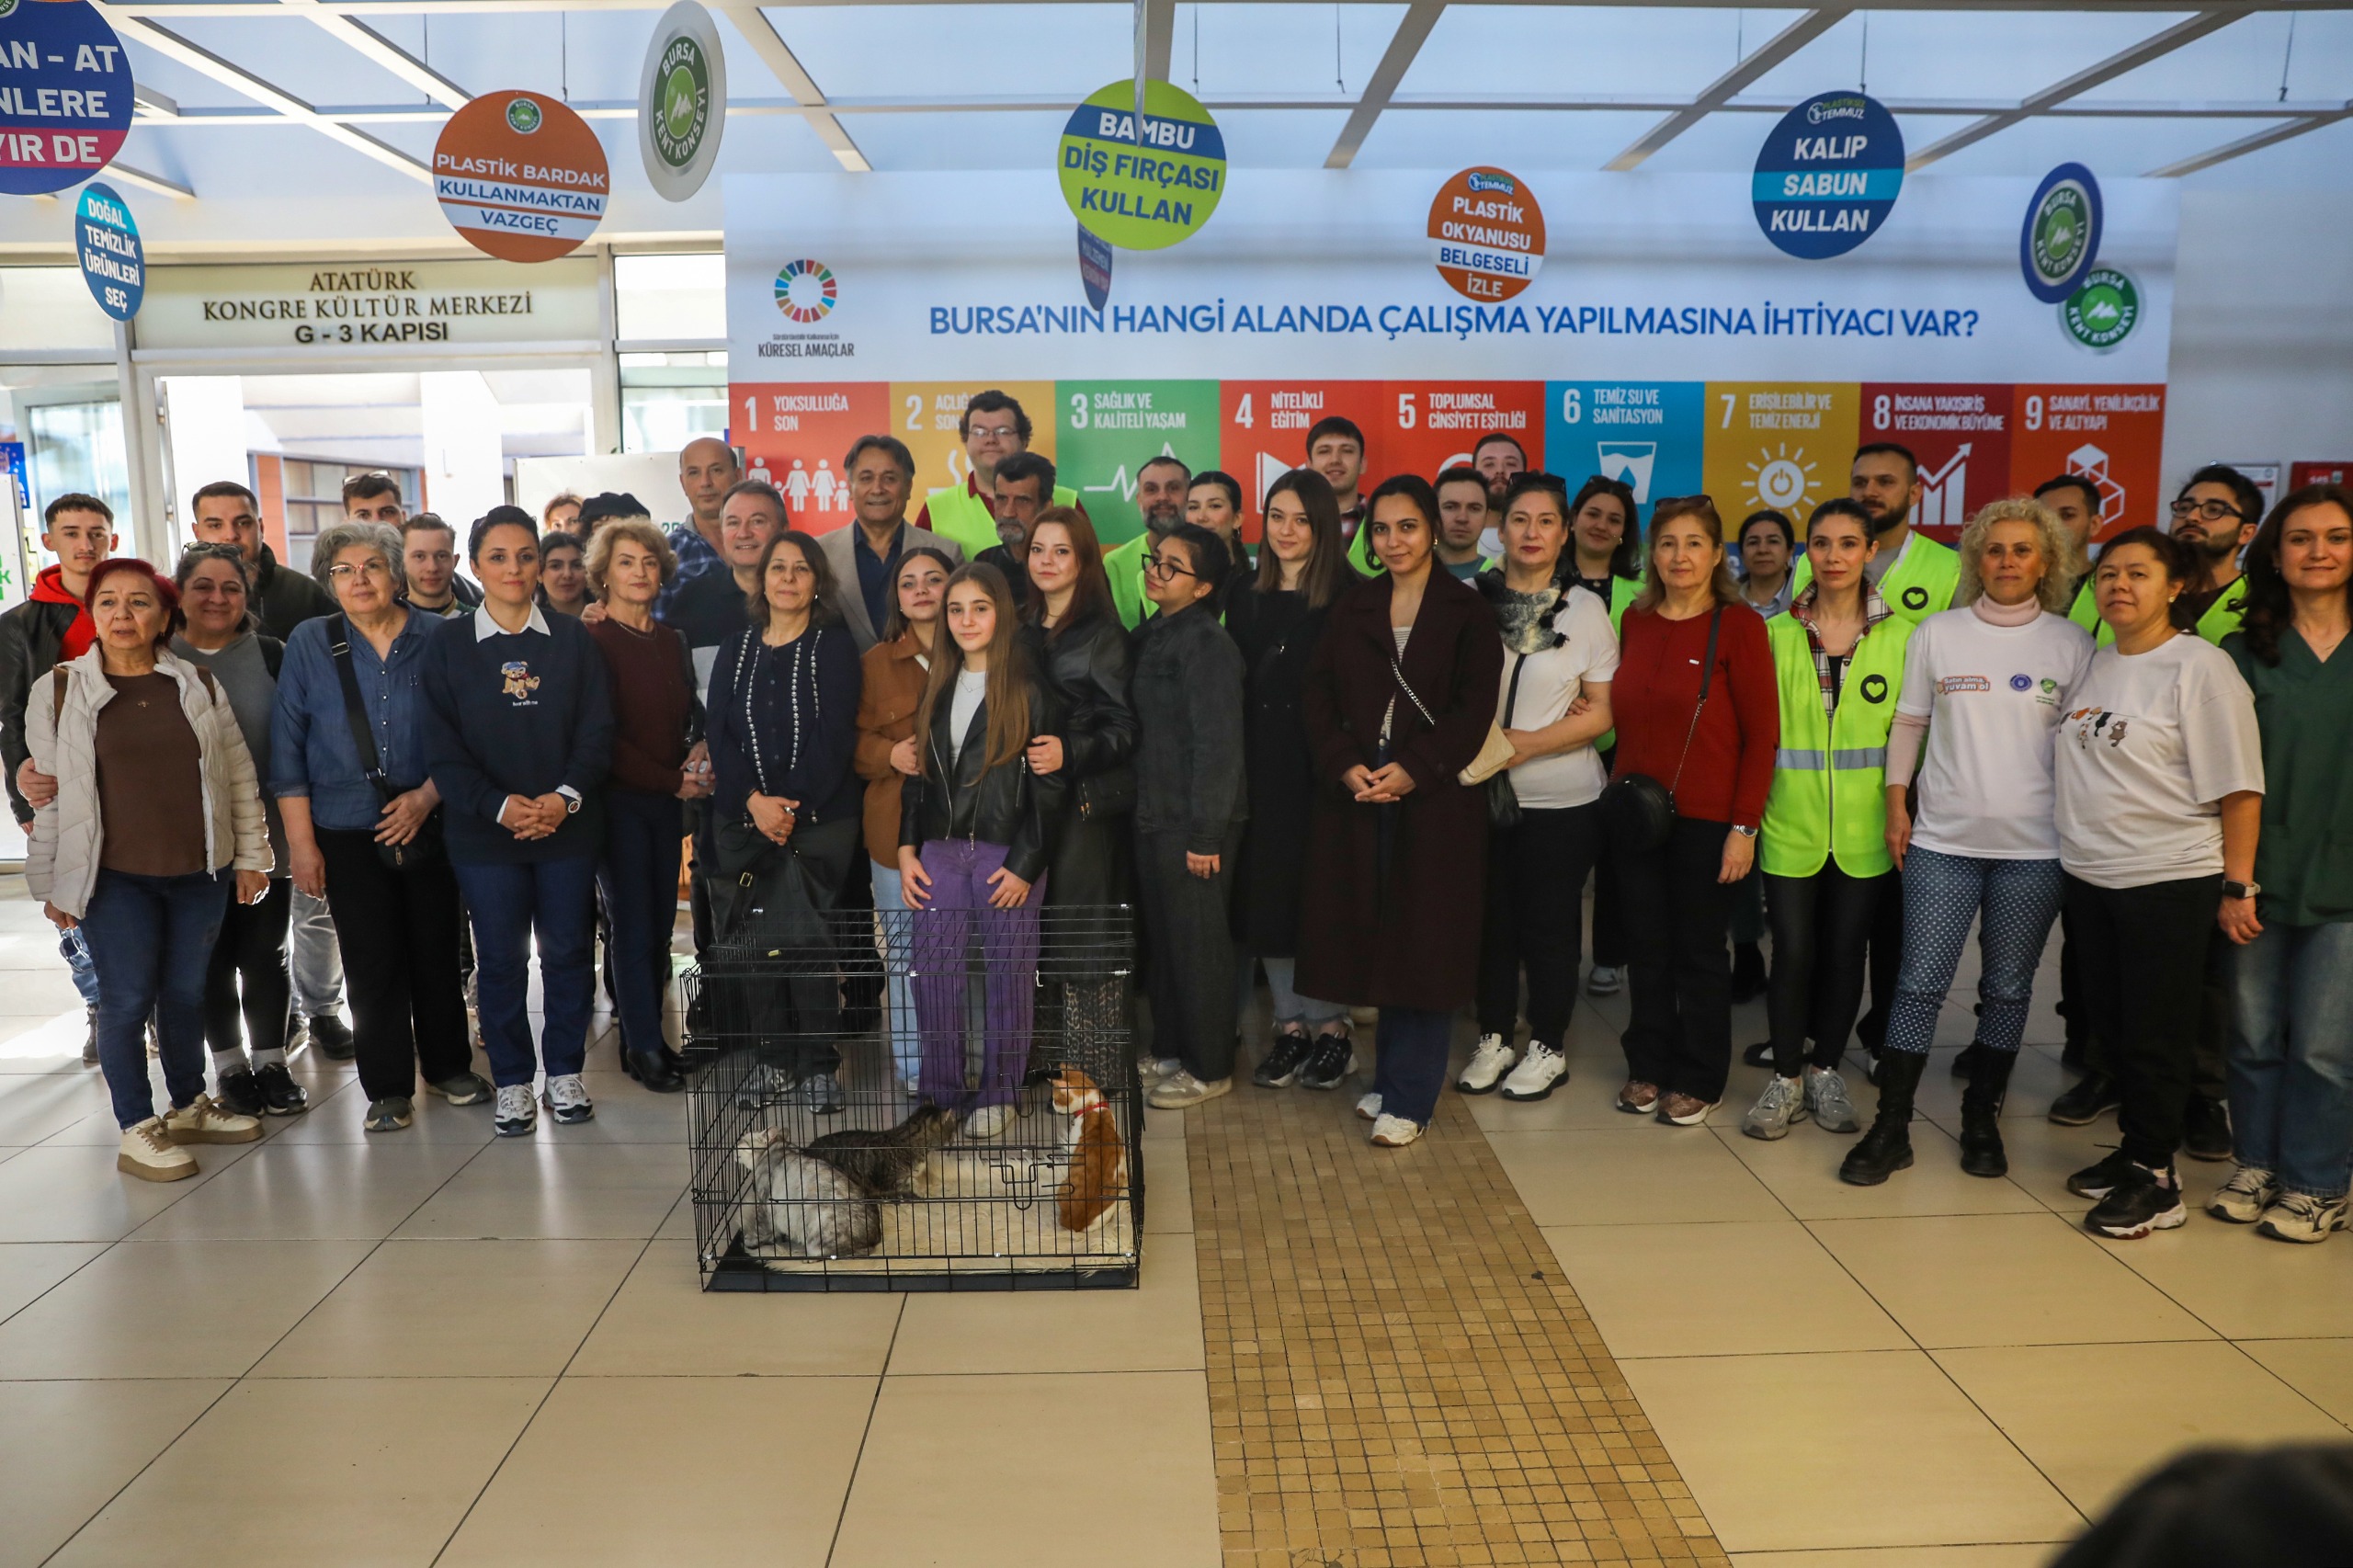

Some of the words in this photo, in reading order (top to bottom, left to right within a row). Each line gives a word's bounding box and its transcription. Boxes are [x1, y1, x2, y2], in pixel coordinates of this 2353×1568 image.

[74, 44, 119, 73] AT
[662, 42, 695, 77] BURSA
[655, 109, 675, 156] KENT
[1098, 112, 1195, 149] BAMBU
[0, 133, 46, 162] IR
[52, 135, 102, 163] DE
[1793, 135, 1868, 161] KALIP
[437, 153, 518, 177] PLASTİK
[523, 165, 606, 187] BARDAK
[1064, 142, 1108, 178] DİŞ
[1114, 153, 1219, 191] FIRÇASI
[439, 180, 600, 211] KULLANMAKTAN
[1782, 172, 1868, 197] SABUN
[87, 197, 127, 229] DOĞAL
[1080, 187, 1193, 226] KULLAN
[1453, 196, 1524, 224] PLASTİK
[1770, 209, 1870, 232] KULLAN
[480, 210, 559, 235] VAZGEÇ
[1441, 221, 1531, 250] OKYANUSU
[85, 224, 137, 259] TEMİZLİK
[85, 247, 141, 287] ÜRÜNLERİ
[1440, 246, 1529, 276] BELGESELİ
[309, 268, 416, 291] ATATÜRK
[1467, 273, 1503, 297] İZLE
[105, 286, 128, 312] SEÇ
[203, 299, 307, 321] KONGRE
[315, 294, 420, 318] KÜLTÜR
[429, 290, 533, 315] MERKEZİ
[295, 324, 314, 344] G
[339, 324, 353, 342] 3
[361, 322, 449, 342] KAPISI
[930, 305, 1104, 335] BURSA'NIN
[1113, 298, 1224, 334] HANGİ
[1232, 305, 1373, 333] ALANDA
[1380, 305, 1530, 340] ÇALIŞMA
[1536, 306, 1756, 335] YAPILMASINA
[1764, 301, 1893, 336] İHTİYACI
[1901, 309, 1979, 337] VAR?
[758, 342, 802, 358] KÜRESEL
[805, 343, 855, 358] AMAÇLAR
[774, 392, 849, 412] YOKSULLUĞA
[936, 392, 975, 411] AÇLIĞ
[1094, 391, 1136, 409] SAĞLIK
[1137, 393, 1153, 409] VE
[1271, 391, 1324, 409] NİTELİKLİ
[1428, 393, 1495, 409] TOPLUMSAL
[1563, 388, 1581, 424] 6
[1594, 386, 1626, 404] TEMİZ
[1628, 389, 1643, 404] SU
[1644, 389, 1660, 404] VE
[1817, 394, 1832, 410] VE
[745, 396, 757, 432] 1
[774, 415, 799, 431] SON
[906, 394, 923, 430] 2
[936, 415, 961, 430] SON
[1071, 393, 1088, 429] 3
[1094, 411, 1143, 428] KALİTELİ
[1145, 413, 1186, 430] YAŞAM
[1234, 393, 1254, 428] 4
[1271, 411, 1310, 428] EĞİTİM
[1399, 393, 1415, 429] 5
[1428, 410, 1480, 428] CİNSİYET
[1481, 410, 1526, 430] EŞİTLİĞİ
[1593, 405, 1663, 424] SANİTASYON
[1721, 394, 1736, 428] 7
[1873, 394, 1891, 430] 8
[2026, 395, 2042, 430] 9
